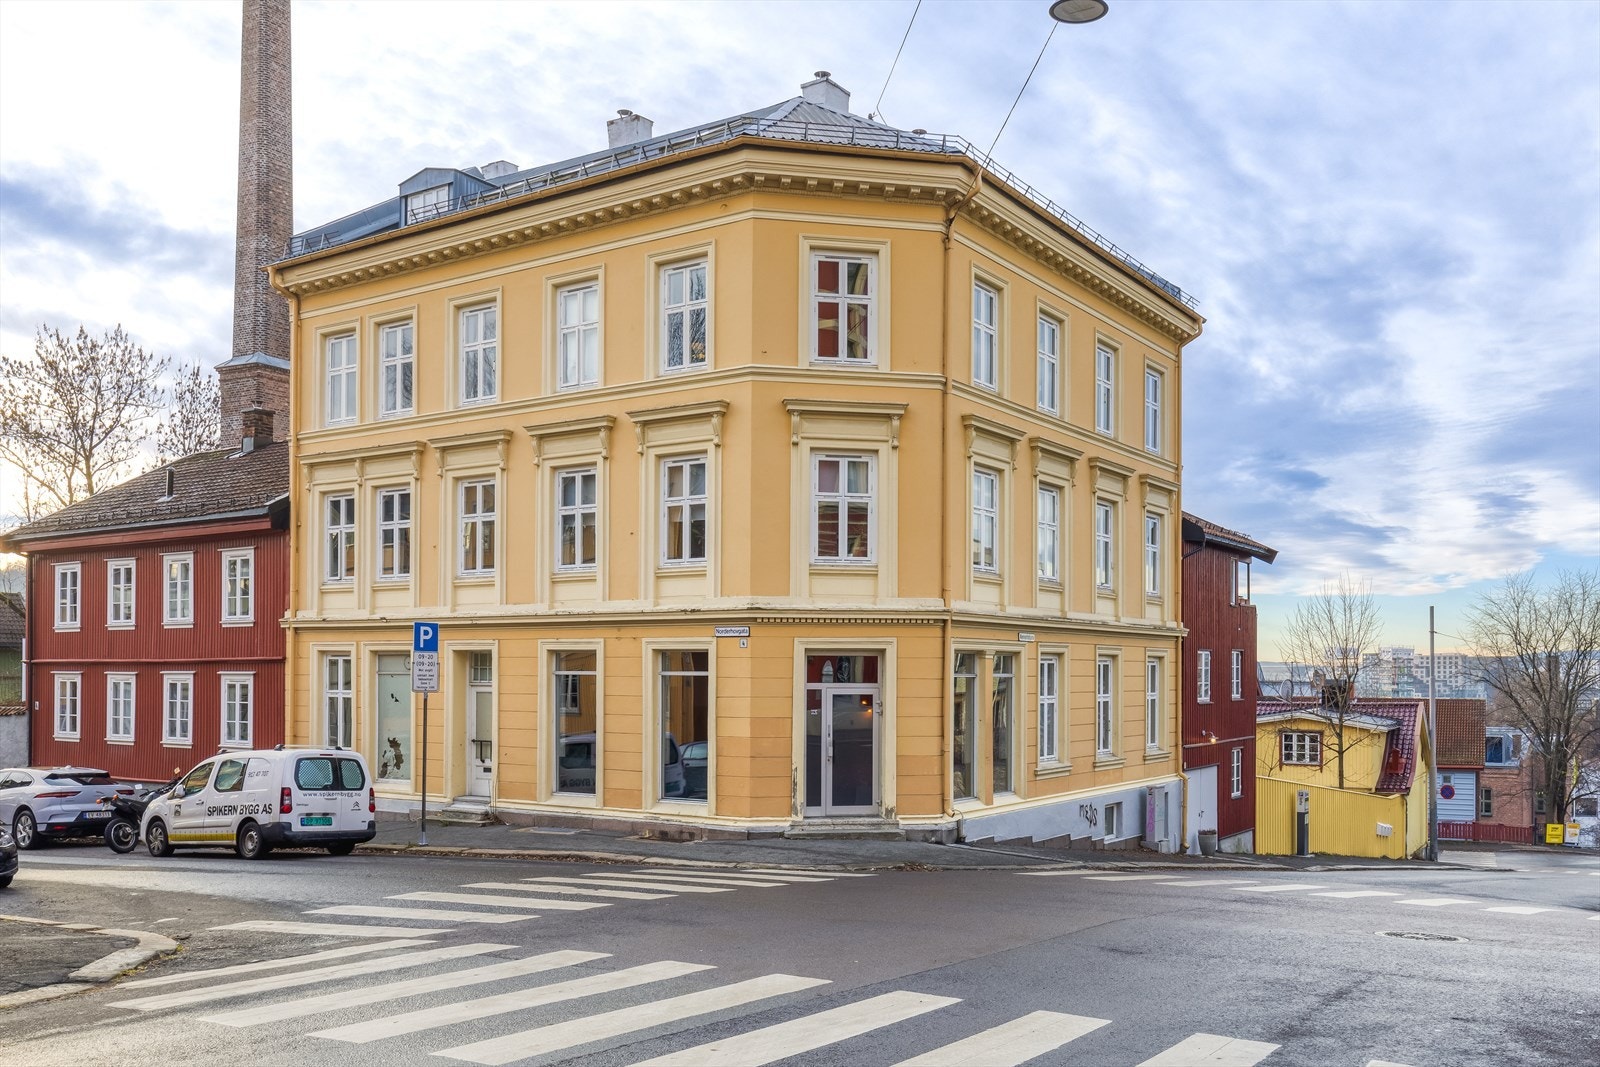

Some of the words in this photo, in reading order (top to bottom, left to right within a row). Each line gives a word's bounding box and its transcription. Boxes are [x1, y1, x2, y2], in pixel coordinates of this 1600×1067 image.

[420, 626, 433, 648] P
[207, 805, 238, 816] SPIKERN
[239, 804, 260, 815] BYGG
[261, 803, 273, 814] AS
